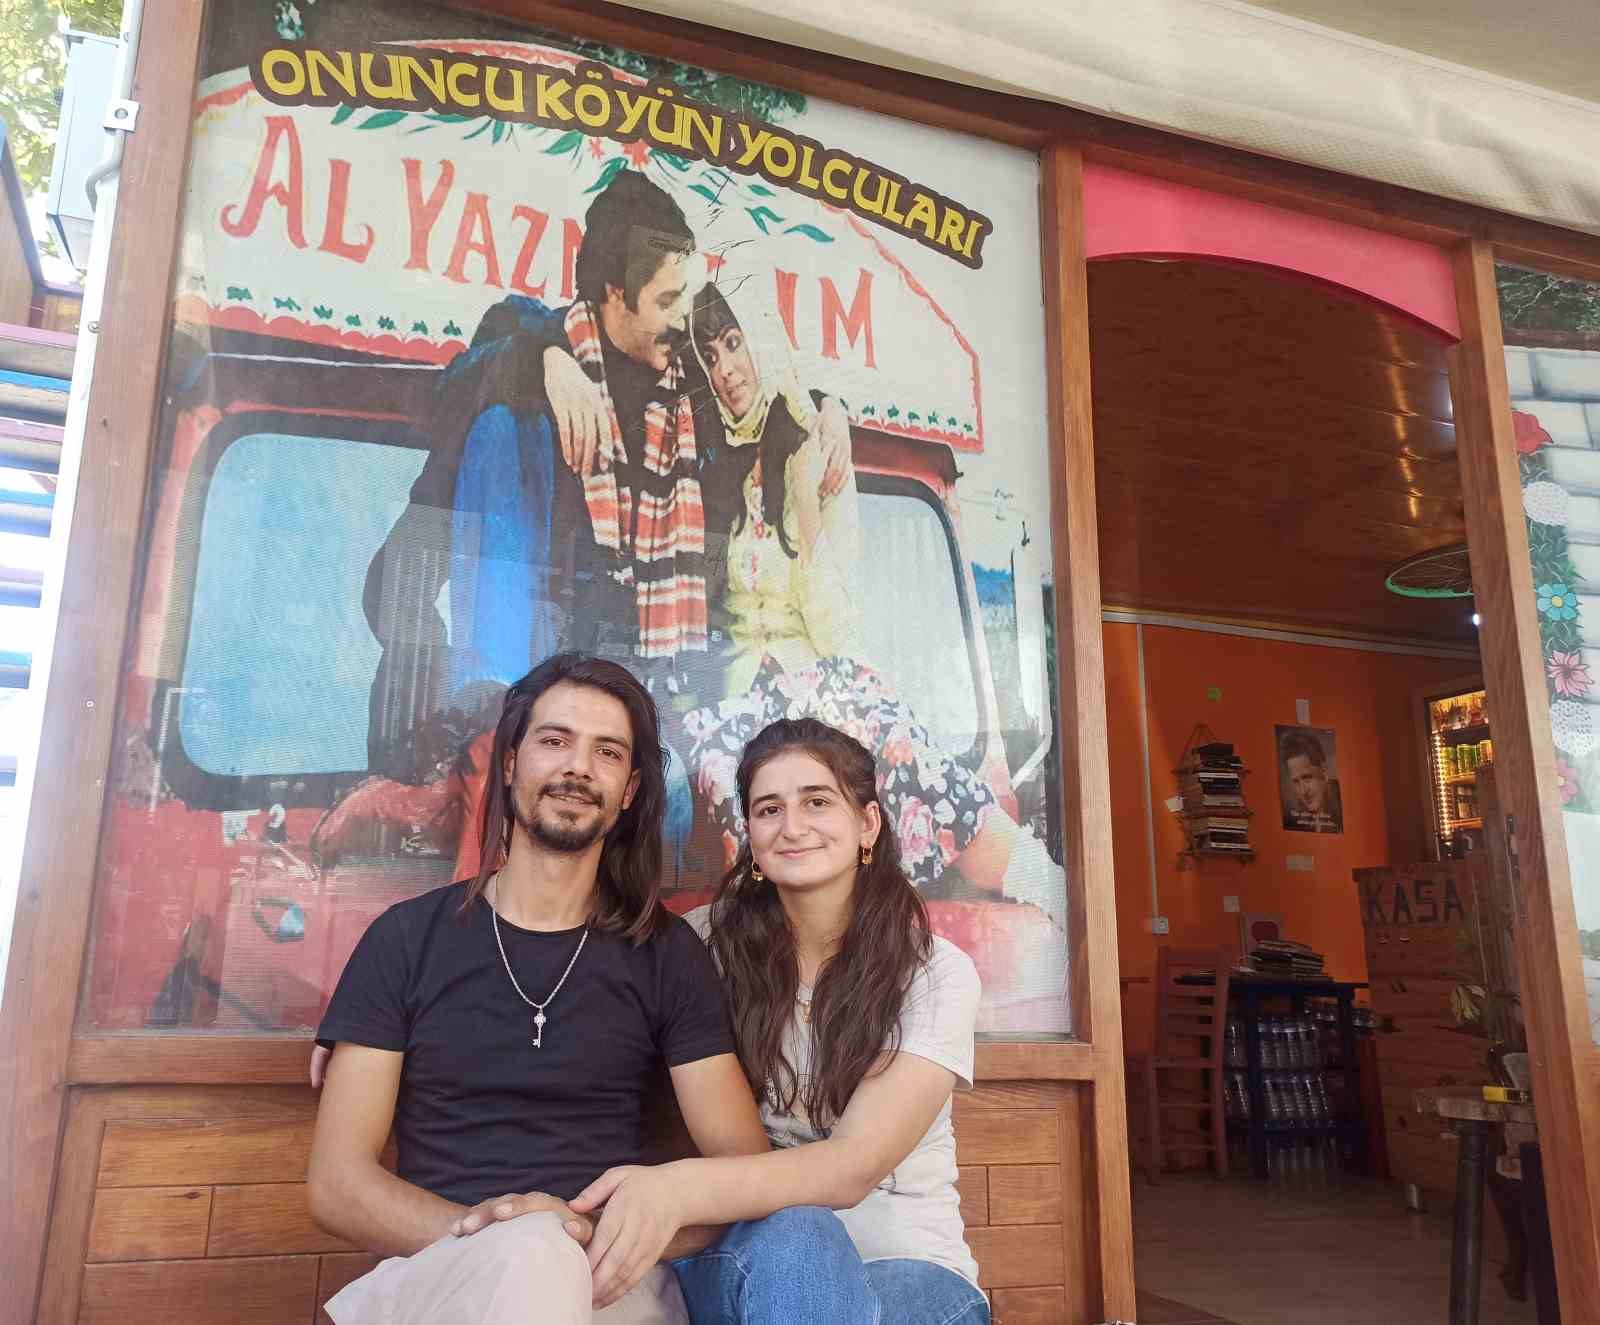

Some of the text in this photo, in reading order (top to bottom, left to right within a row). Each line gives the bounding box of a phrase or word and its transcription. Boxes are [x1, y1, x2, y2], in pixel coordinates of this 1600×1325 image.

[220, 116, 375, 263] AL
[262, 49, 982, 259] ONUNCU KÖYÜN YOLCULARI
[1365, 879, 1465, 922] KASA
